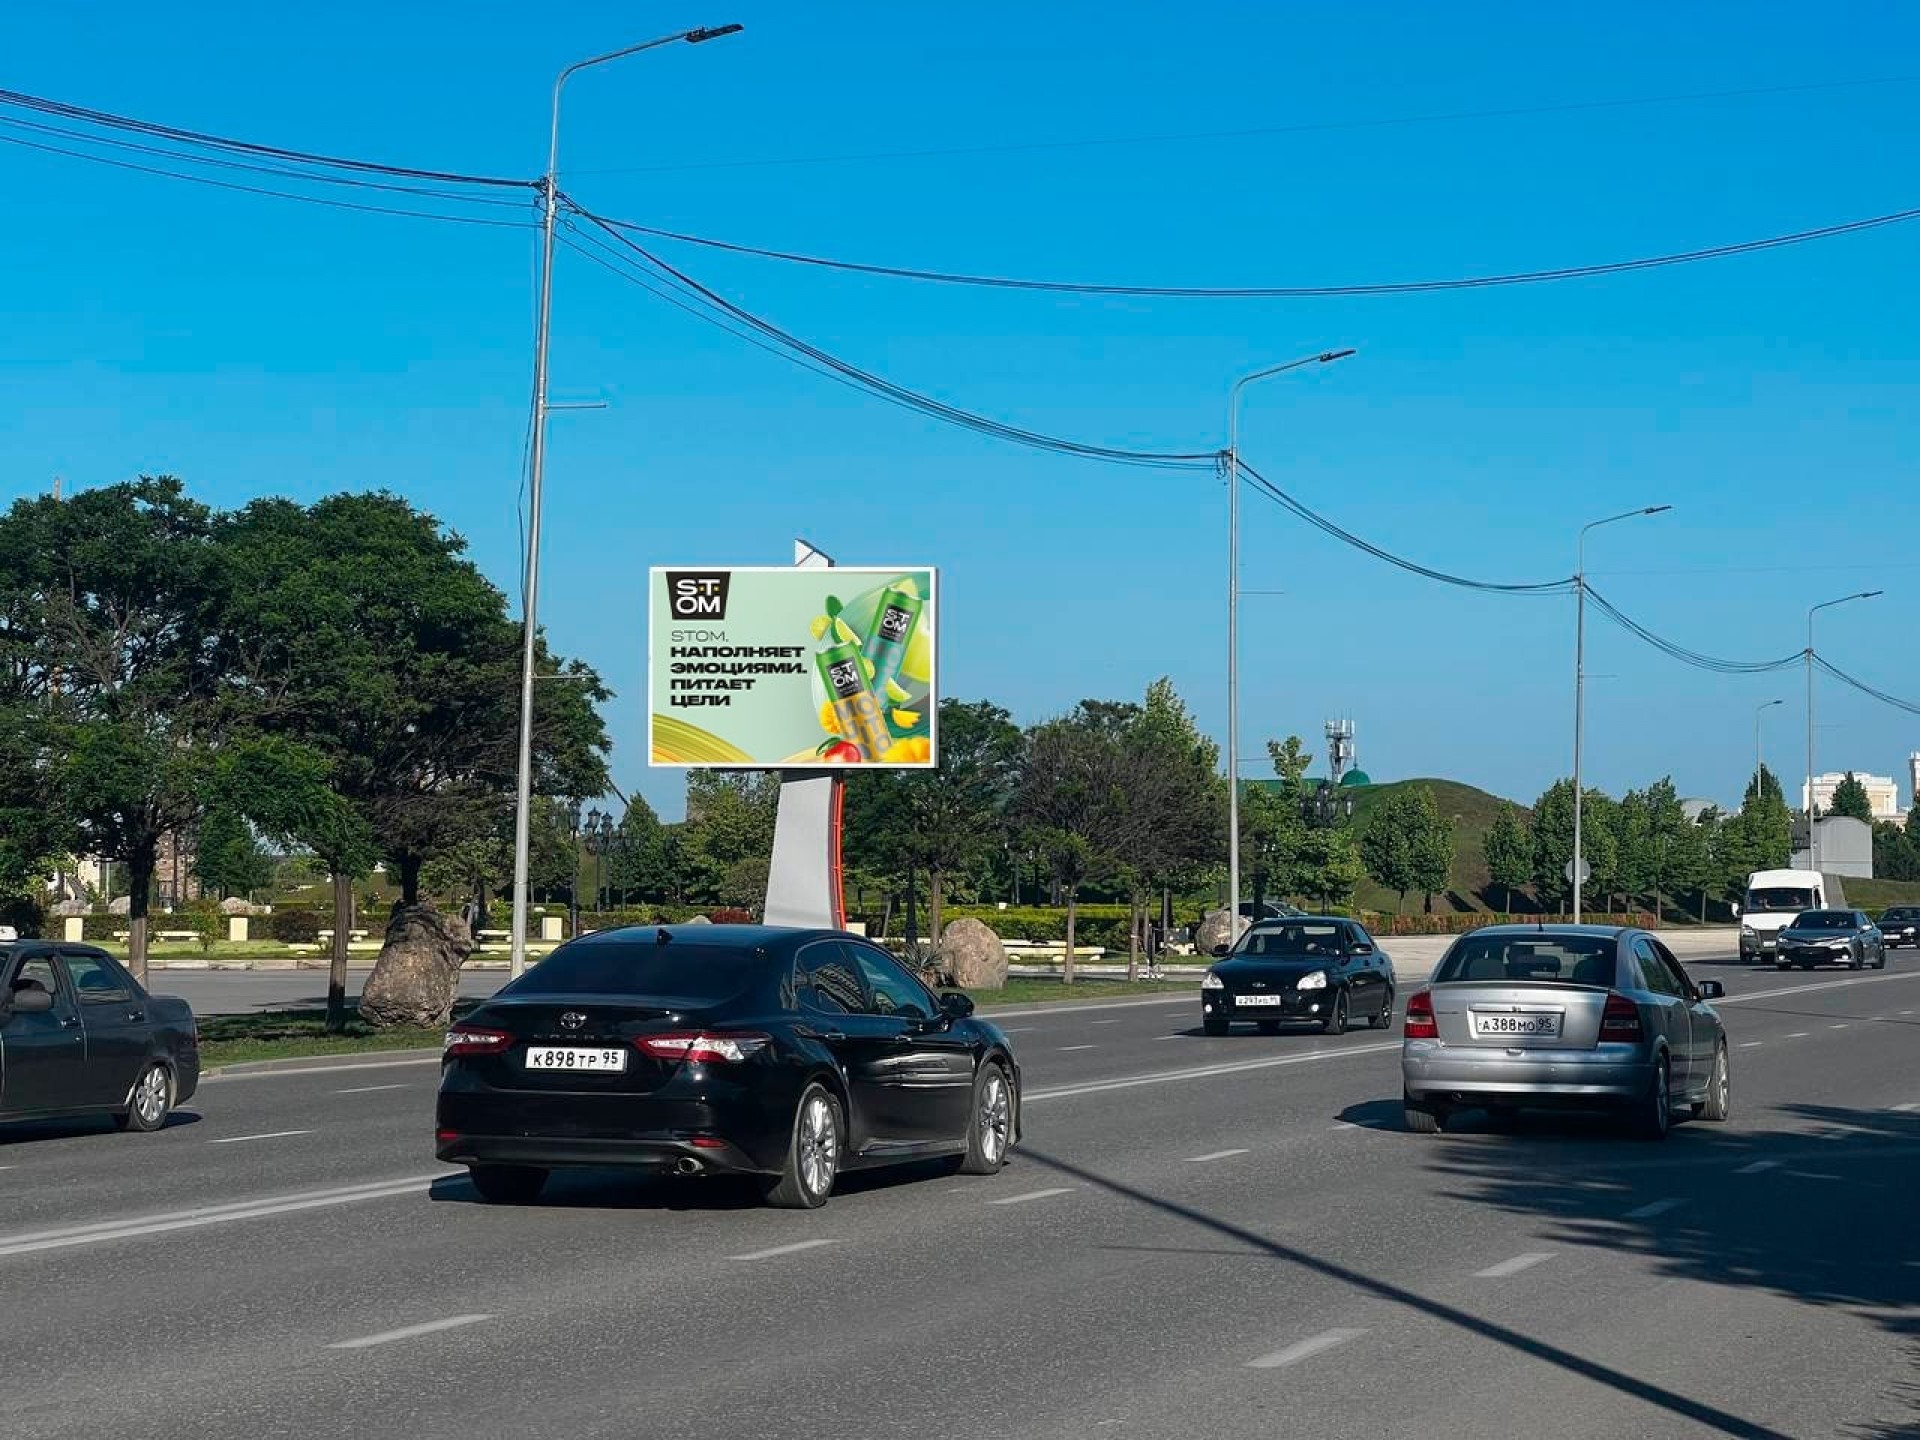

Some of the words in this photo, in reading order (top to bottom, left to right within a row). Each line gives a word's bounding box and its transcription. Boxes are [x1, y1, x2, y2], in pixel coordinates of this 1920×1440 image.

[671, 630, 729, 642] STOM.
[670, 646, 805, 658] НАПОЛНЯЕТ
[670, 662, 808, 675] ЭМОЦИЯМИ.
[670, 679, 756, 690] ПИТАЕТ
[670, 695, 730, 708] ЦЕЛИ
[602, 1052, 619, 1064] 95
